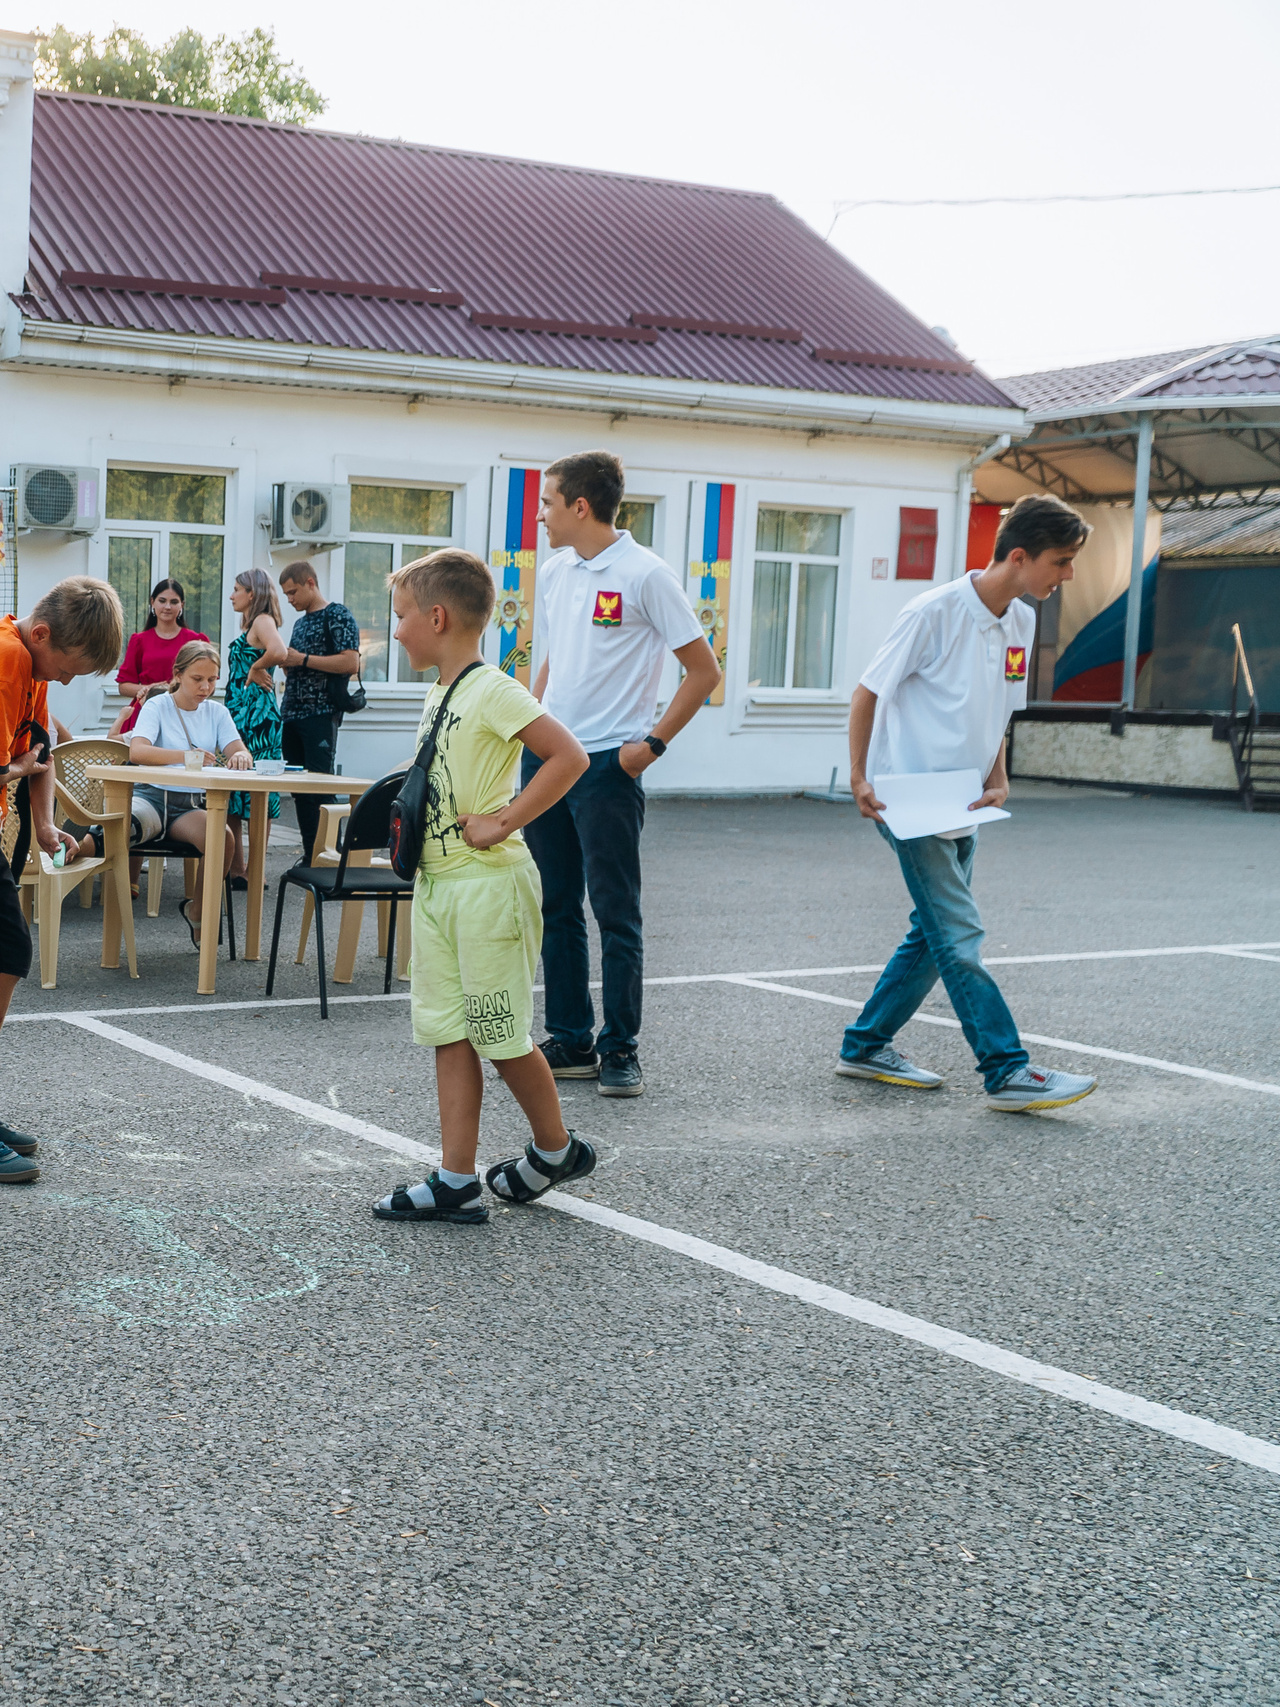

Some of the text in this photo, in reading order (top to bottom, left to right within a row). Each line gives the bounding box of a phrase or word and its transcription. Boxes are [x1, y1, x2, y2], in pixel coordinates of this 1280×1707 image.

[491, 550, 535, 569] 1941-1945
[907, 538, 924, 565] 61
[690, 560, 730, 579] 1941-1945
[463, 990, 511, 1018] RBAN
